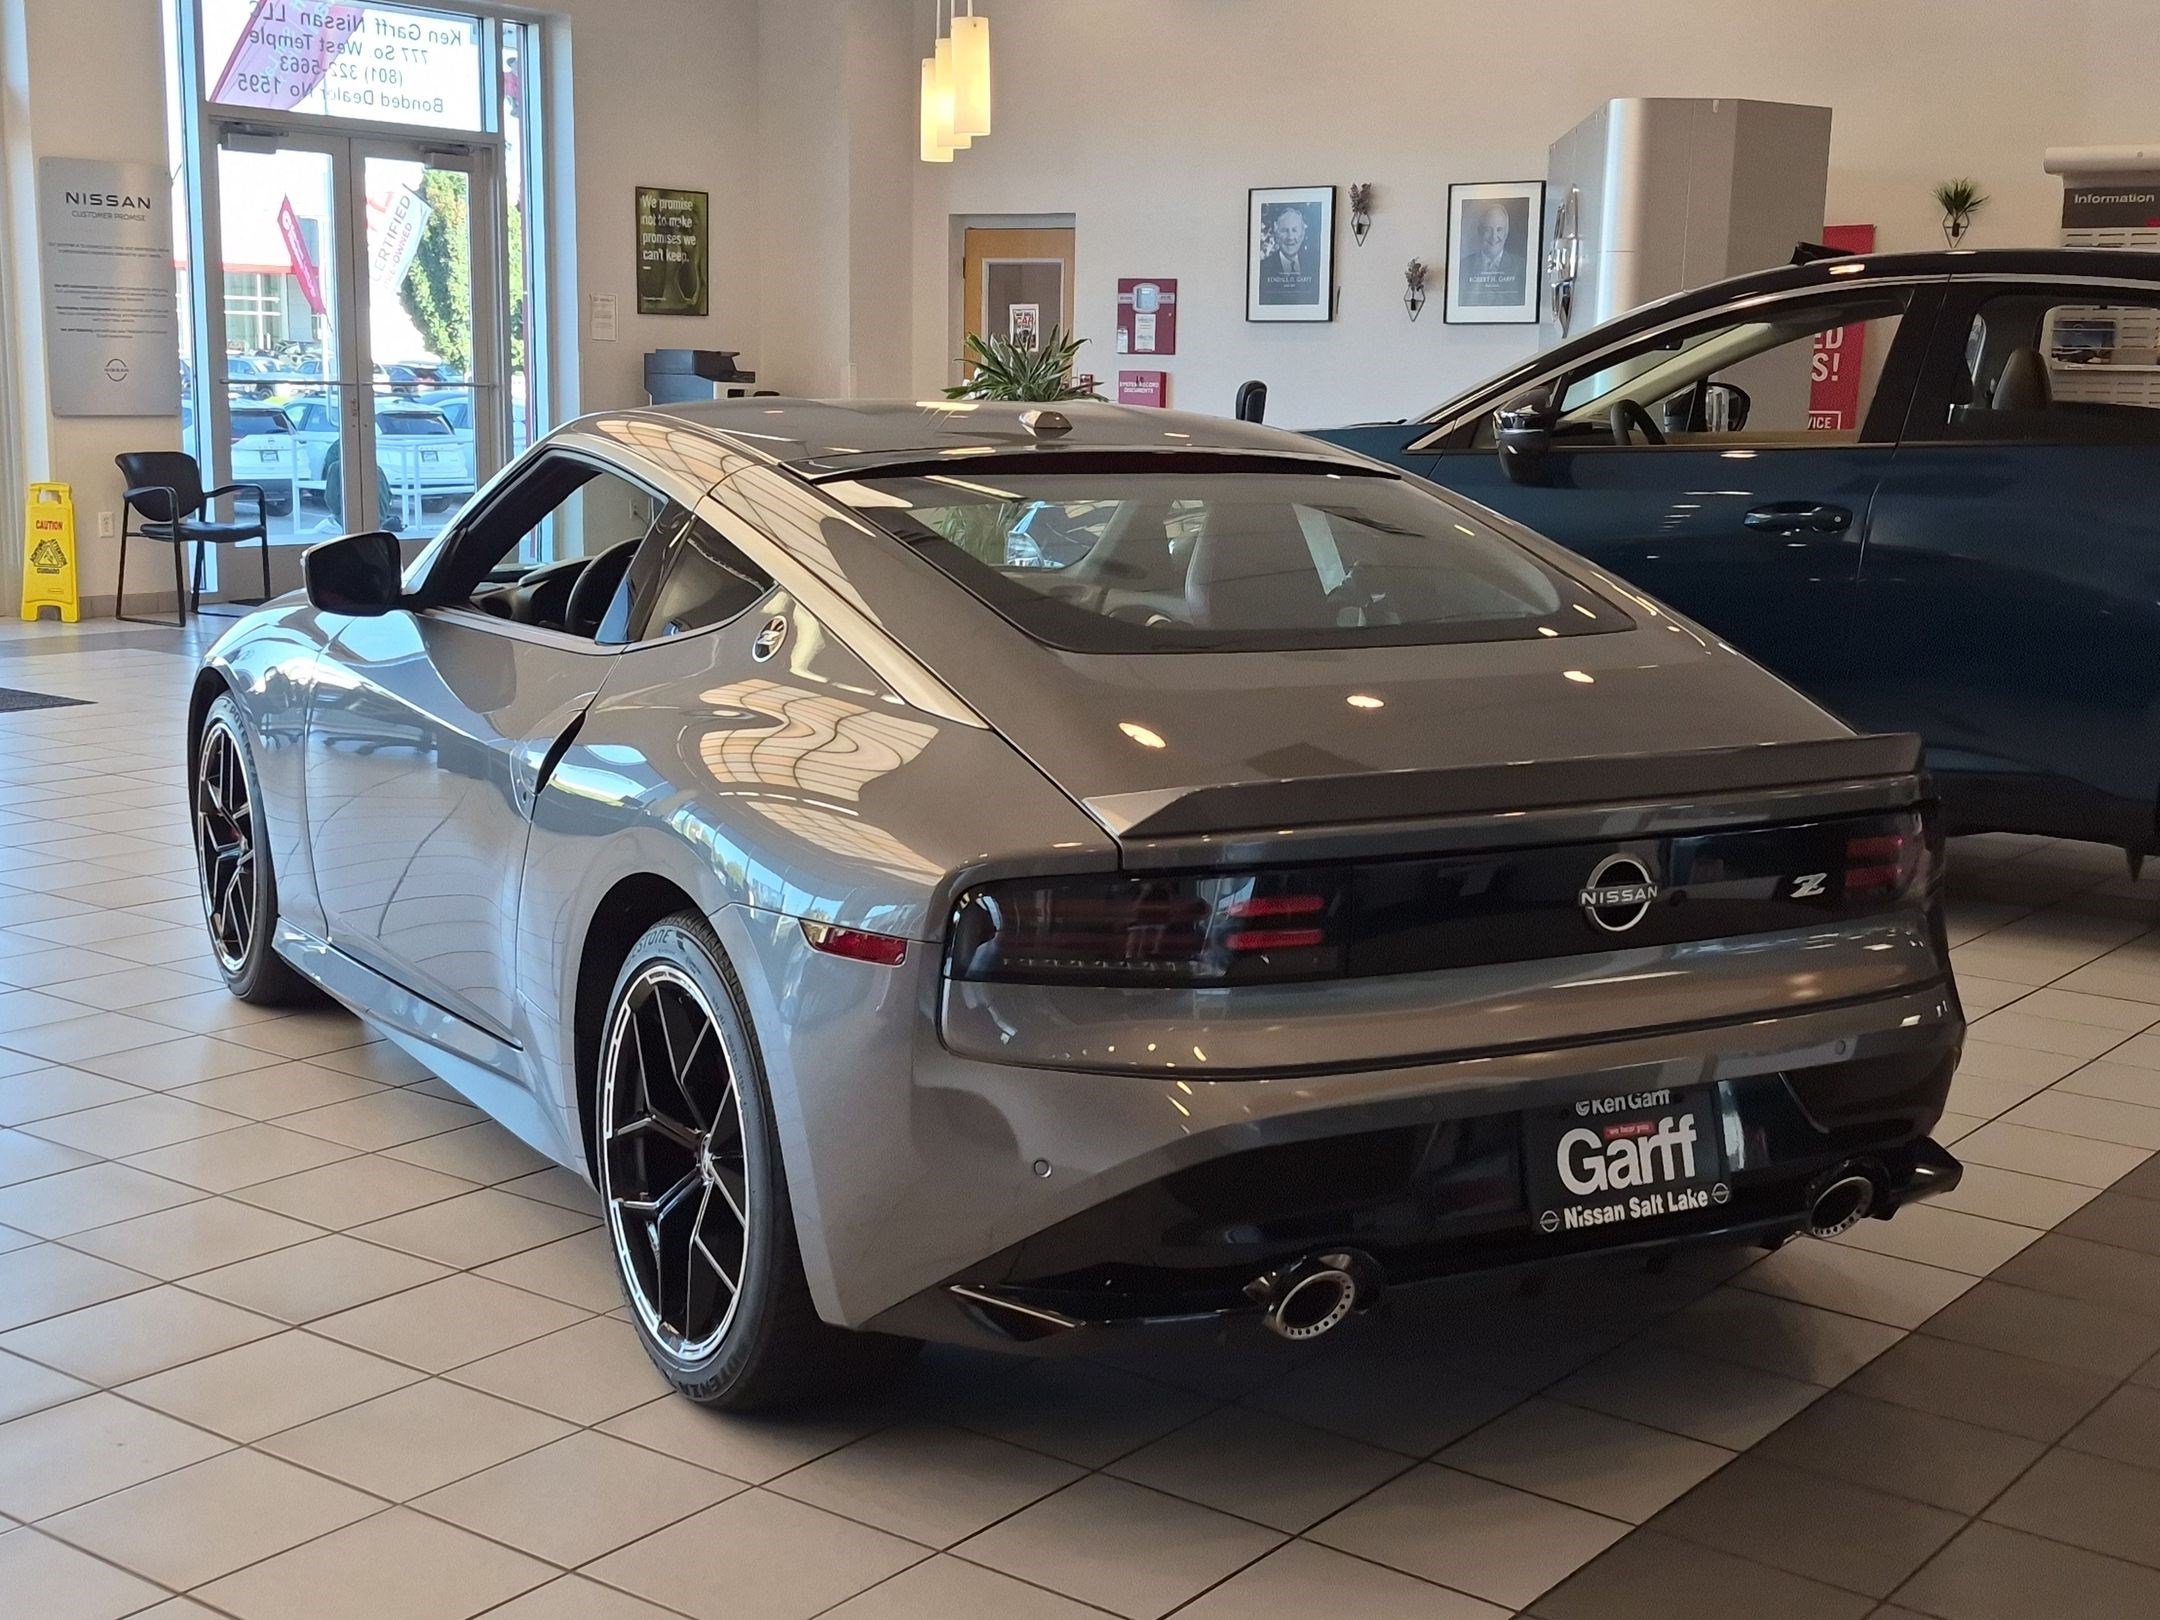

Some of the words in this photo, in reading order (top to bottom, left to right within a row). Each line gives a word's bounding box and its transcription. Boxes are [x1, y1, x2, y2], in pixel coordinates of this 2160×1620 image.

[65, 191, 152, 210] NISSAN
[641, 194, 657, 209] We
[659, 197, 694, 212] promise
[2074, 193, 2155, 204] Information
[642, 214, 657, 226] not
[658, 214, 667, 226] to
[668, 215, 693, 228] make
[371, 195, 411, 282] CERTIFIED
[642, 231, 682, 246] promises
[683, 235, 697, 246] we
[642, 248, 664, 261] can't
[36, 520, 64, 530] CAUTION
[1581, 885, 1658, 905] NISSAN
[1557, 1113, 1698, 1196] Garff
[1563, 1203, 1626, 1230] Nissan
[1628, 1193, 1665, 1219] Salt
[1667, 1188, 1709, 1213] Lake
